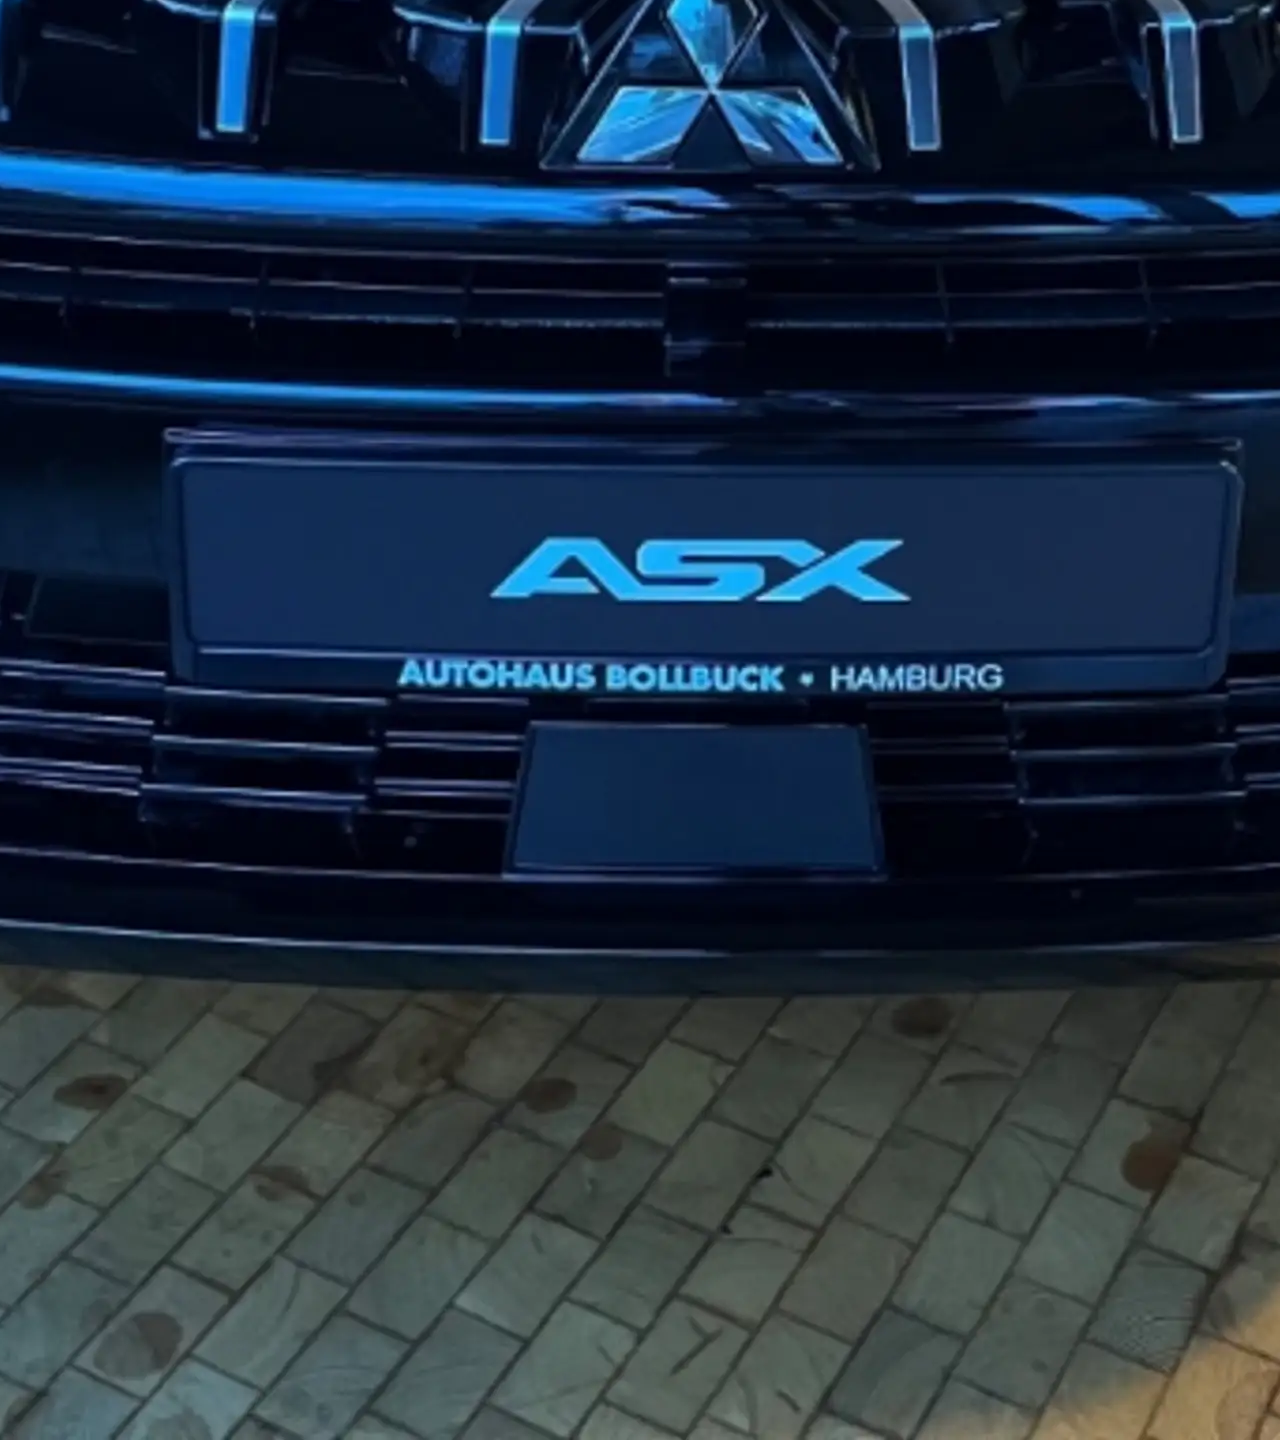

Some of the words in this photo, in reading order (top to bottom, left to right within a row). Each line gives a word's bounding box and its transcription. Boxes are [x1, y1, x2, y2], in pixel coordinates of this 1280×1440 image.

[490, 536, 911, 601] ASX
[397, 658, 596, 690] AUTOHAUS
[605, 663, 785, 693] BOLLBUCK
[830, 663, 1004, 693] HAMBURG
